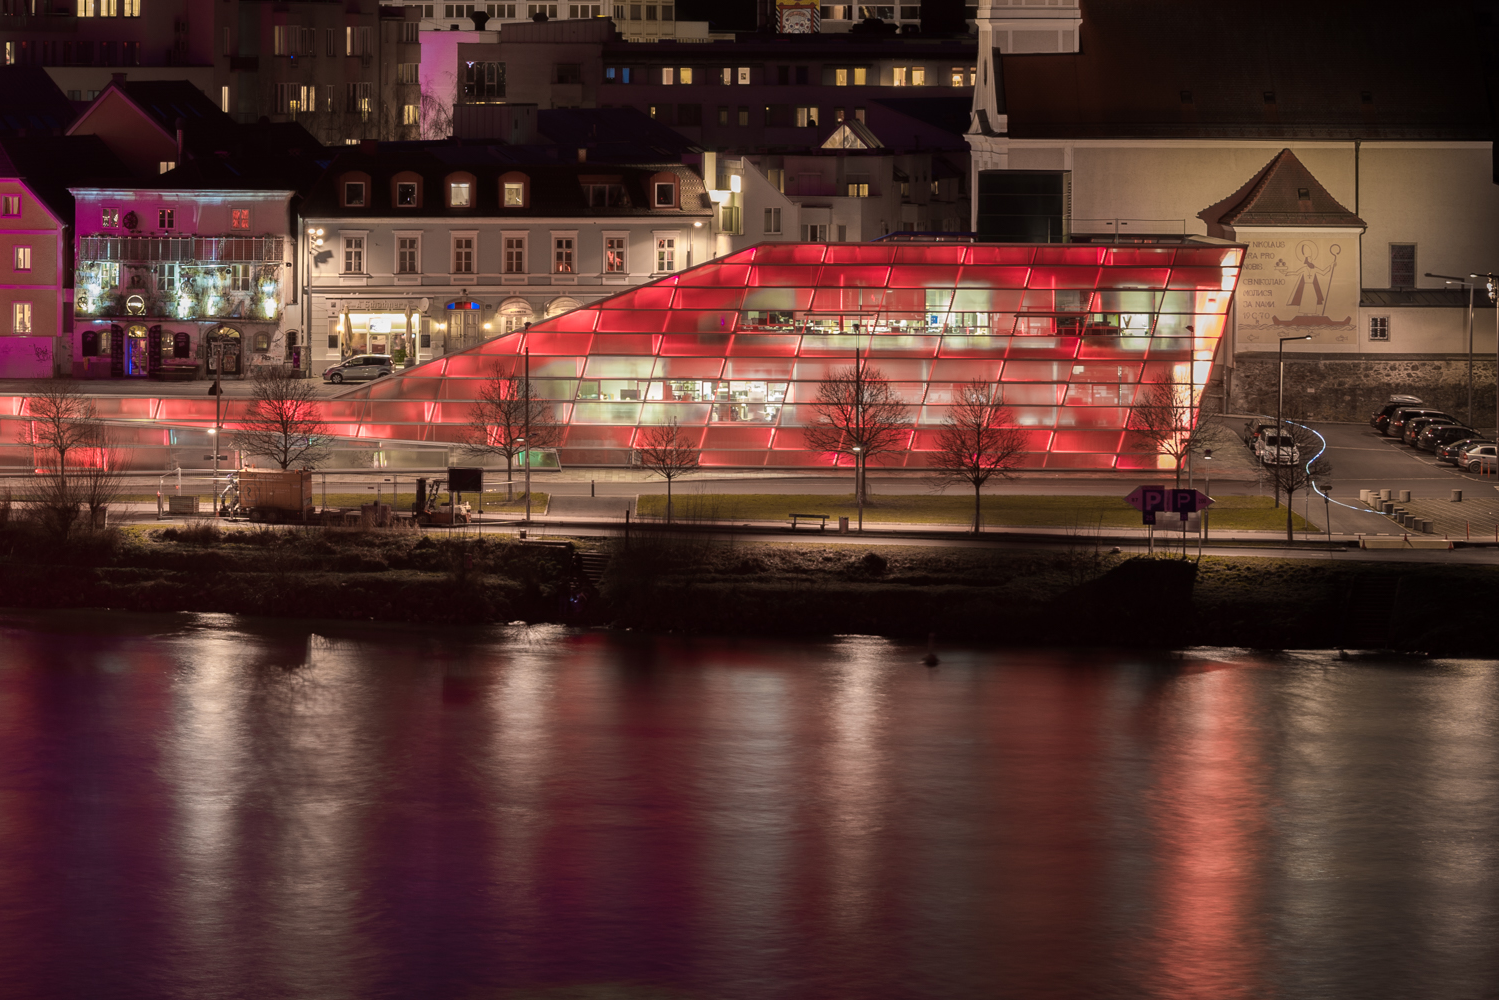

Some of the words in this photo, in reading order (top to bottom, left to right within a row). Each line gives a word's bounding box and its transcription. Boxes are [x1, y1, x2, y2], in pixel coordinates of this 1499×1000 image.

[1252, 240, 1286, 248] NIKOLAUS
[1146, 492, 1162, 510] P
[1177, 493, 1191, 509] P
